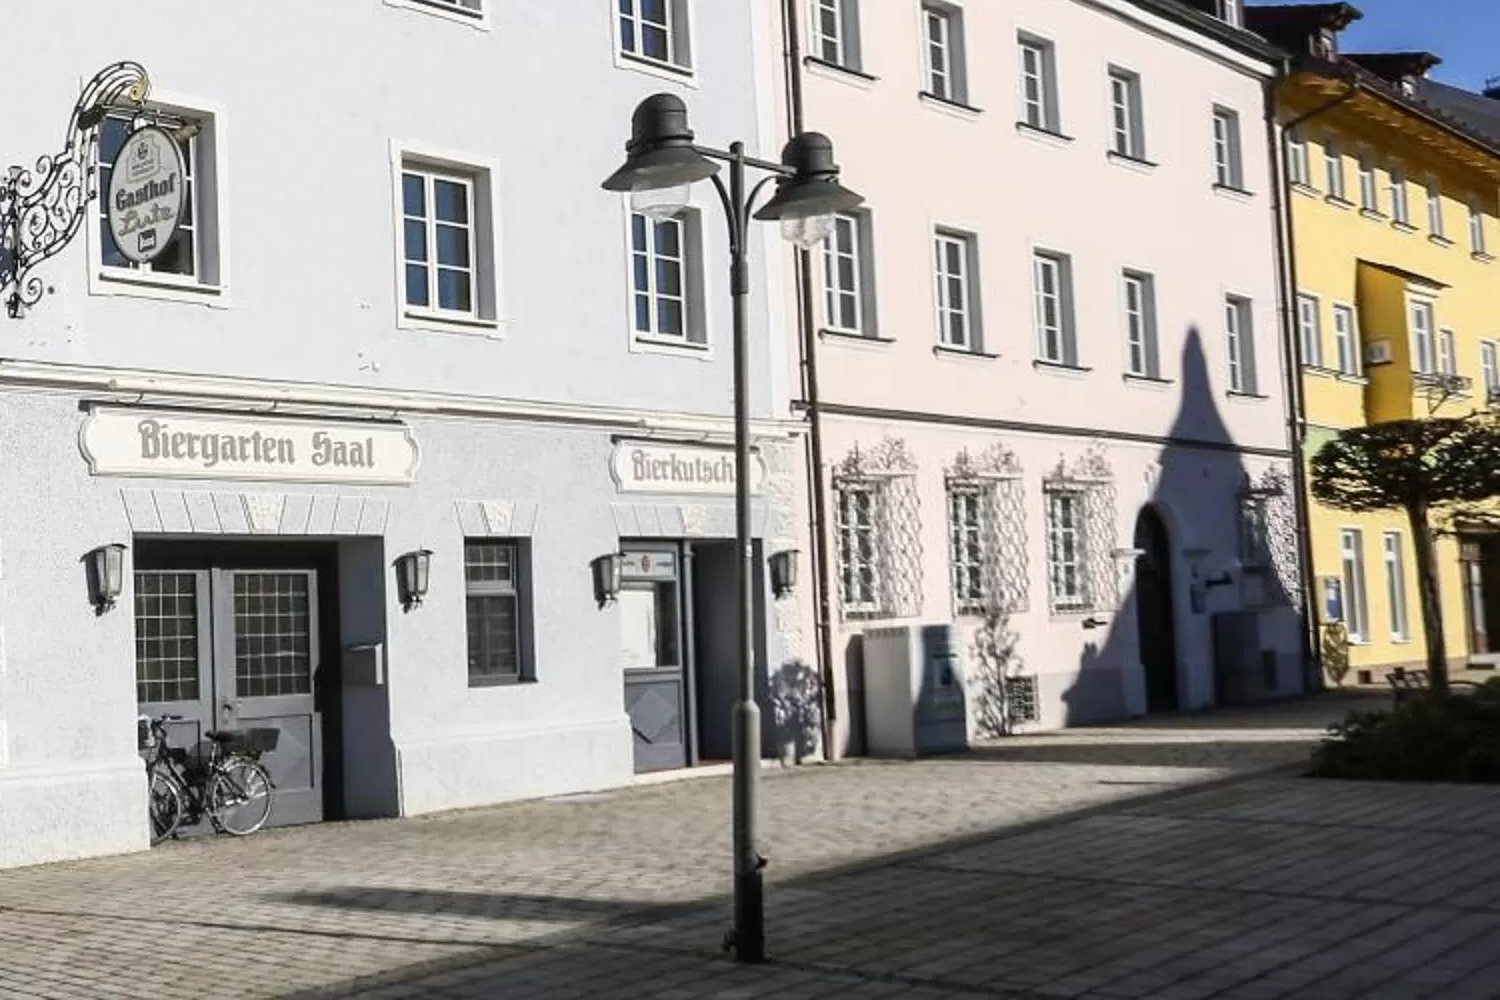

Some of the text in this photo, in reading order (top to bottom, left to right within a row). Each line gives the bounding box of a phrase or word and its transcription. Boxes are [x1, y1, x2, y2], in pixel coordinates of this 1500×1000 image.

[137, 418, 375, 469] Biergarten Saal
[631, 449, 737, 484] Bierkutsch
